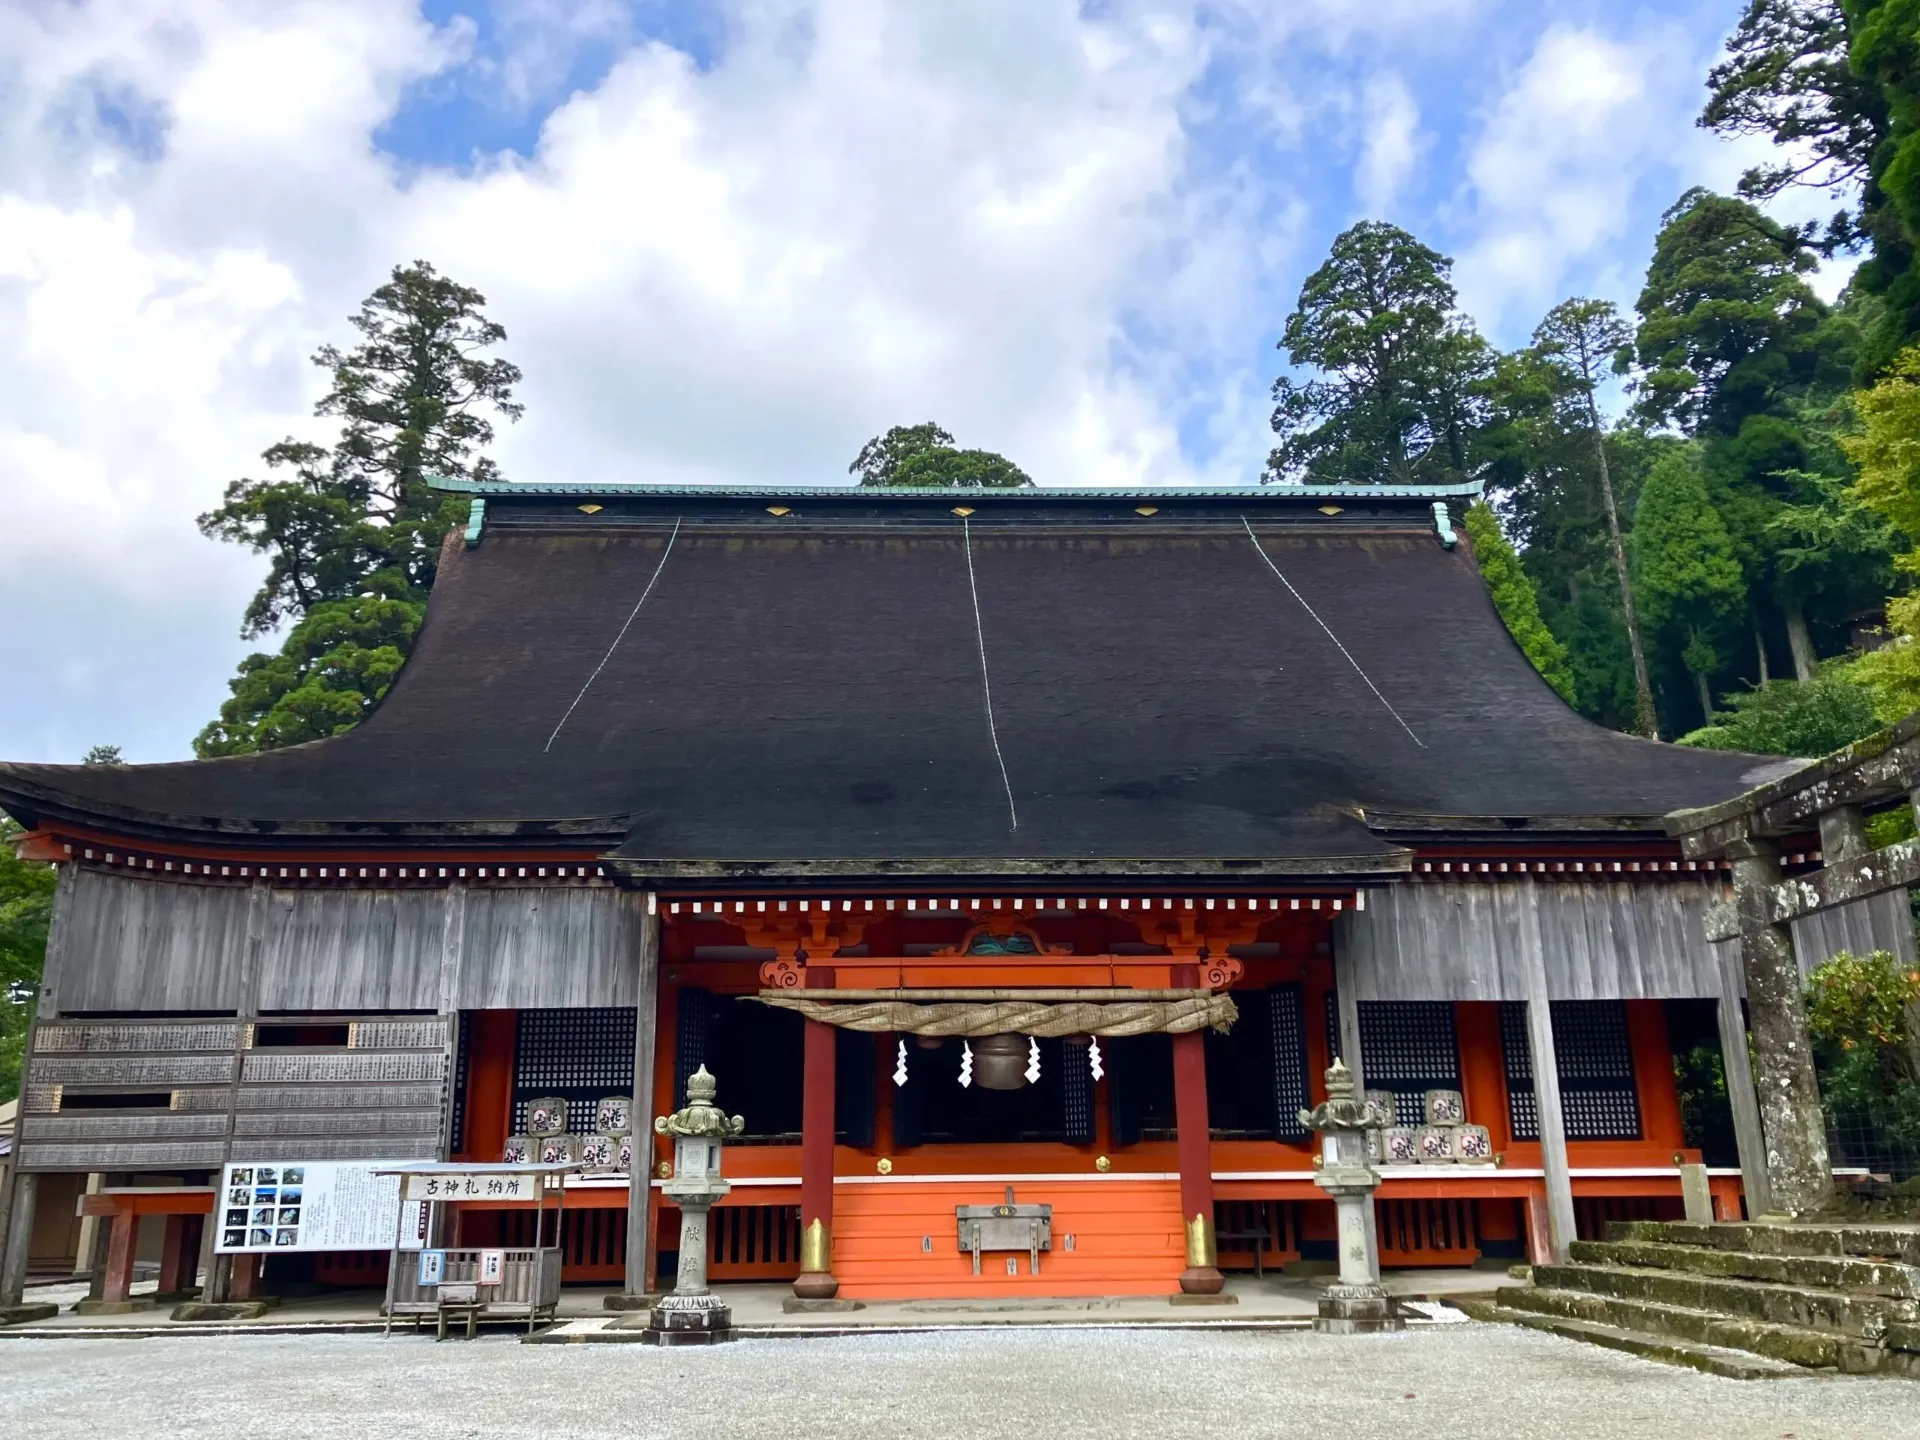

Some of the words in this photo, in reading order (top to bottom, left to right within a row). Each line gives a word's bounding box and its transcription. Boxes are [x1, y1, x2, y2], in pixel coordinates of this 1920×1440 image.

[426, 1179, 520, 1195] 古神札納所
